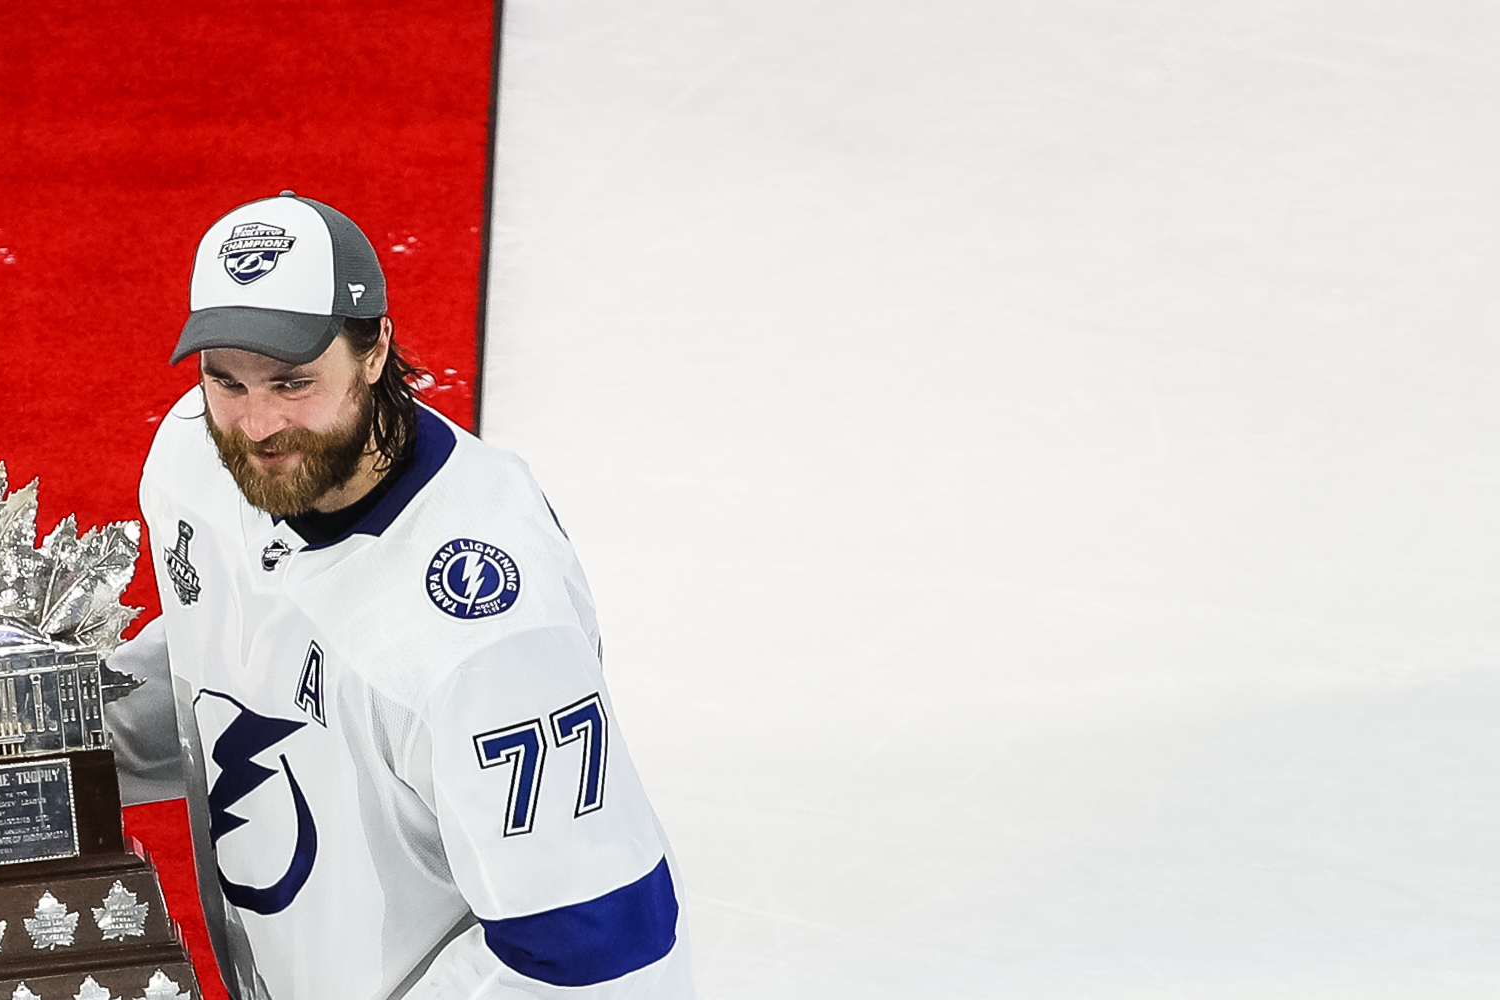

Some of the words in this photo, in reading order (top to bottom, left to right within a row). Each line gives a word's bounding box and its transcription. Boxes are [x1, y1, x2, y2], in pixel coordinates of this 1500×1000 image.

[221, 239, 290, 253] CHAMPIONS
[163, 548, 200, 592] FINAL
[432, 543, 455, 570] BAY
[459, 540, 518, 592] LIGHTNING
[429, 572, 458, 614] TAMPA
[295, 639, 328, 729] A
[15, 768, 60, 786] TROPHY
[472, 691, 608, 839] 77
